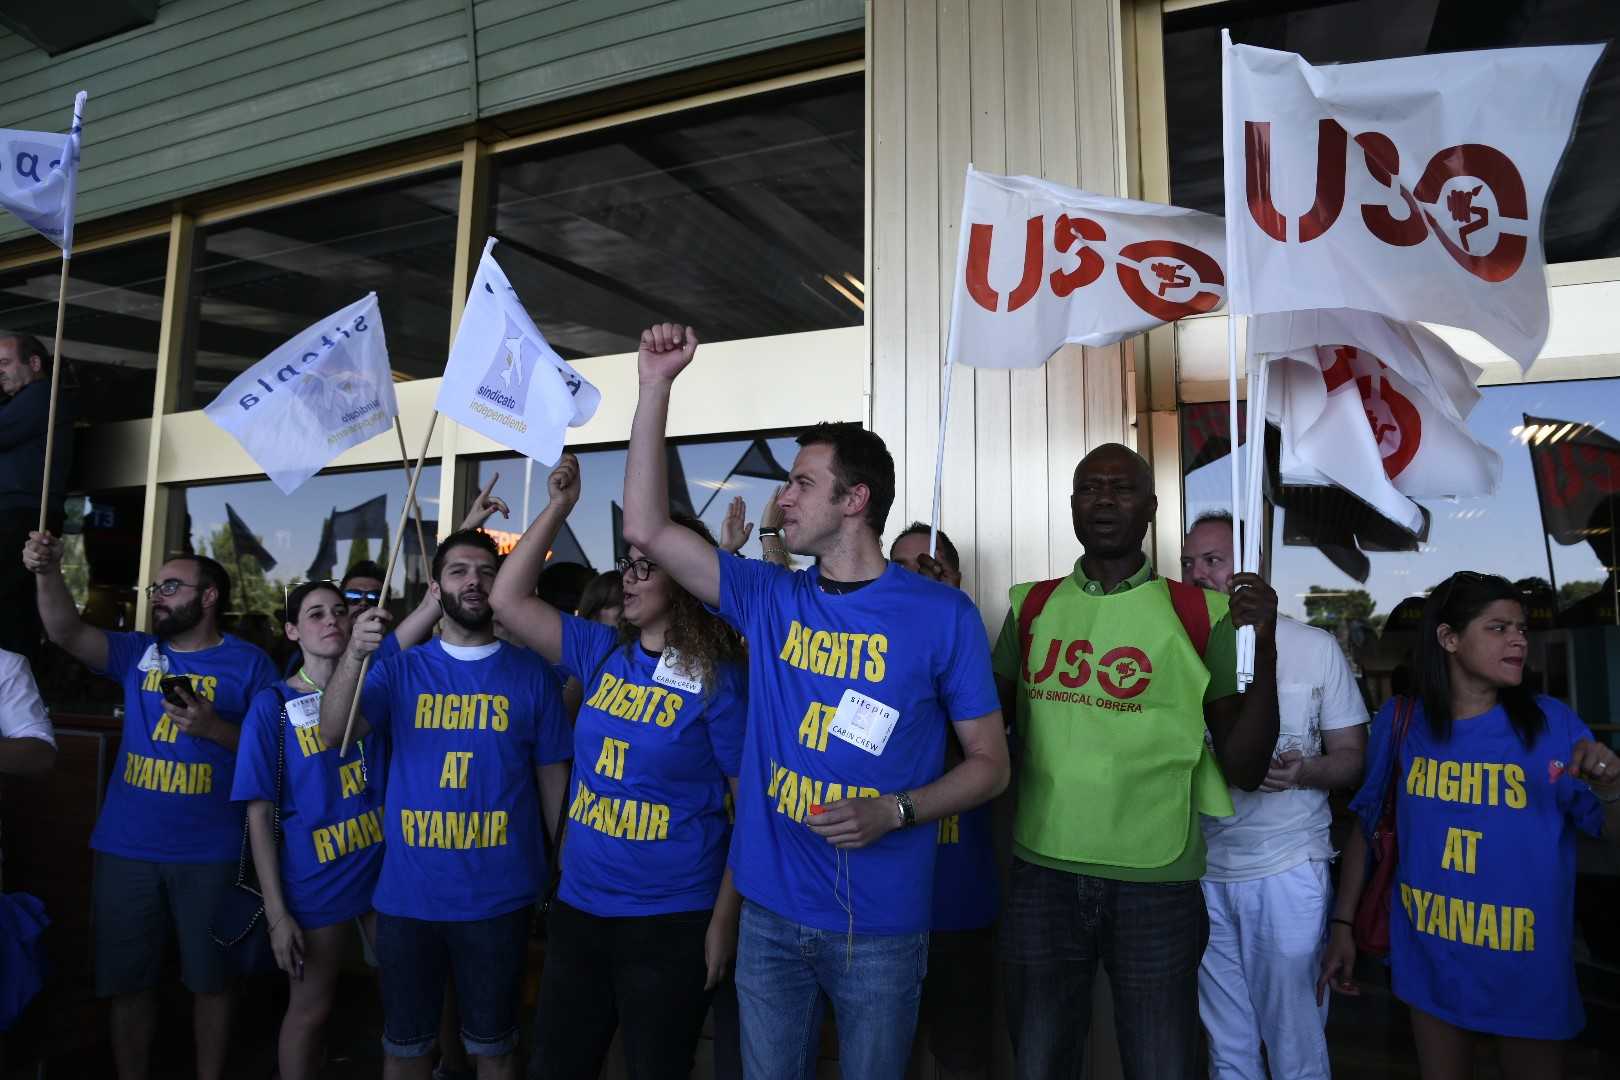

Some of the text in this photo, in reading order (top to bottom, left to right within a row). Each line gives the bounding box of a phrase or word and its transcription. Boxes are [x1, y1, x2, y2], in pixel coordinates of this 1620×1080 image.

[1244, 118, 1528, 283] USO
[965, 213, 1225, 322] USO
[477, 384, 516, 410] sindicato
[779, 620, 888, 682] RIGHTS
[1021, 634, 1153, 699] USO
[141, 668, 217, 702] RITS
[586, 672, 684, 728] RIGHTS
[656, 675, 698, 691] CABIN CREW
[1045, 688, 1093, 706] SINDICAL
[1095, 698, 1143, 713] OBRERA
[414, 693, 510, 732] RIGHTS
[798, 701, 838, 752] AT
[850, 696, 890, 719] sitcpla
[594, 736, 630, 780] AT
[832, 725, 855, 740] CABIN
[855, 736, 879, 752] CREW
[124, 752, 213, 794] RYANAIR
[339, 759, 366, 799] AT
[439, 751, 474, 789] AT
[1406, 756, 1527, 809] RIGHTS
[400, 809, 508, 850] RYANAIR
[568, 779, 671, 841] RYANAIR
[1441, 827, 1483, 874] AT
[1400, 882, 1536, 952] RYANAIR
